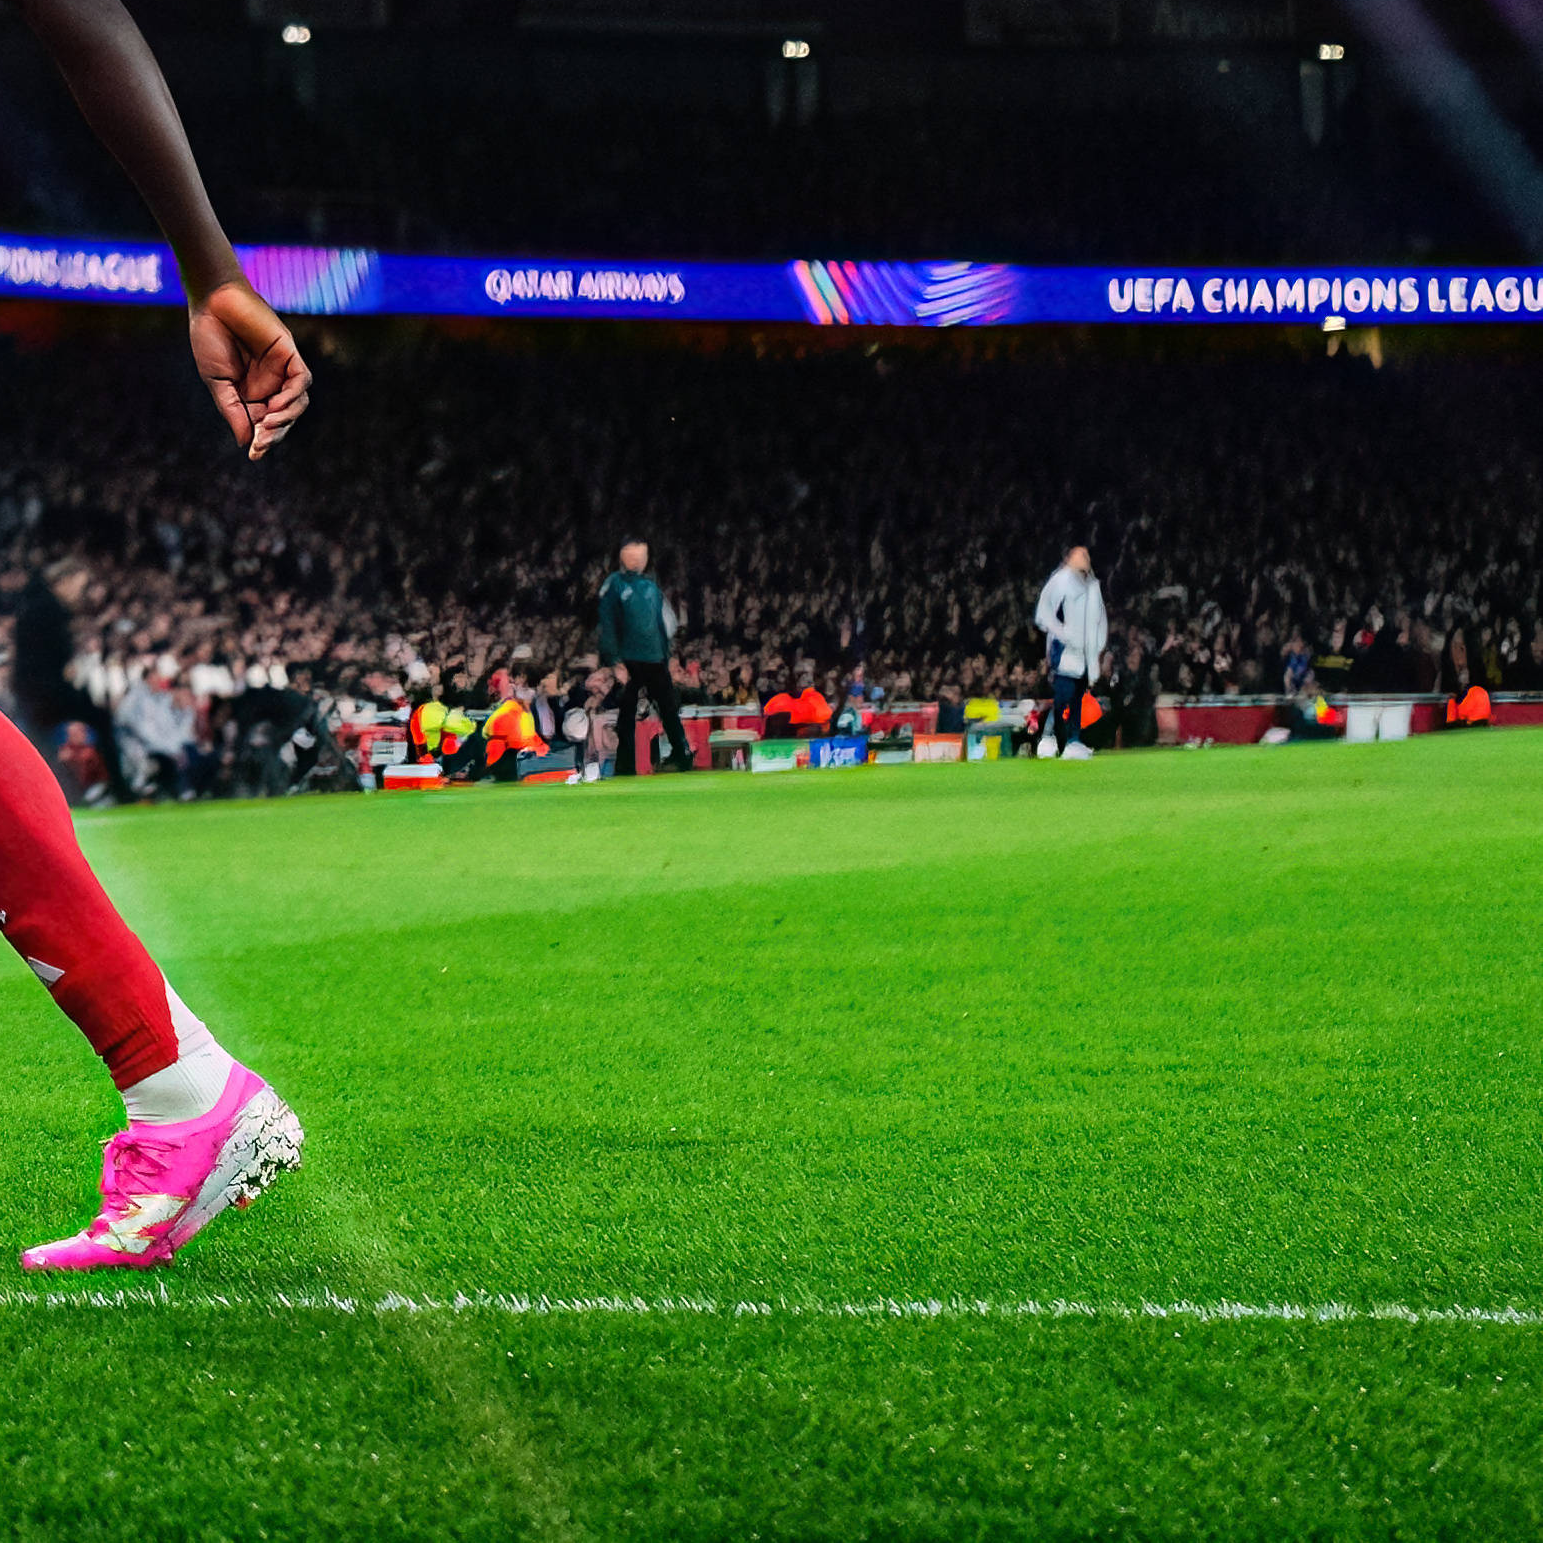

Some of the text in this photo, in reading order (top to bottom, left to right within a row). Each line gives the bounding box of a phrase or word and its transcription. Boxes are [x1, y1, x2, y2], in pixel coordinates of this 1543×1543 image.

[1108, 277, 1543, 314] UEFA CHAMPIONS LEAGU
